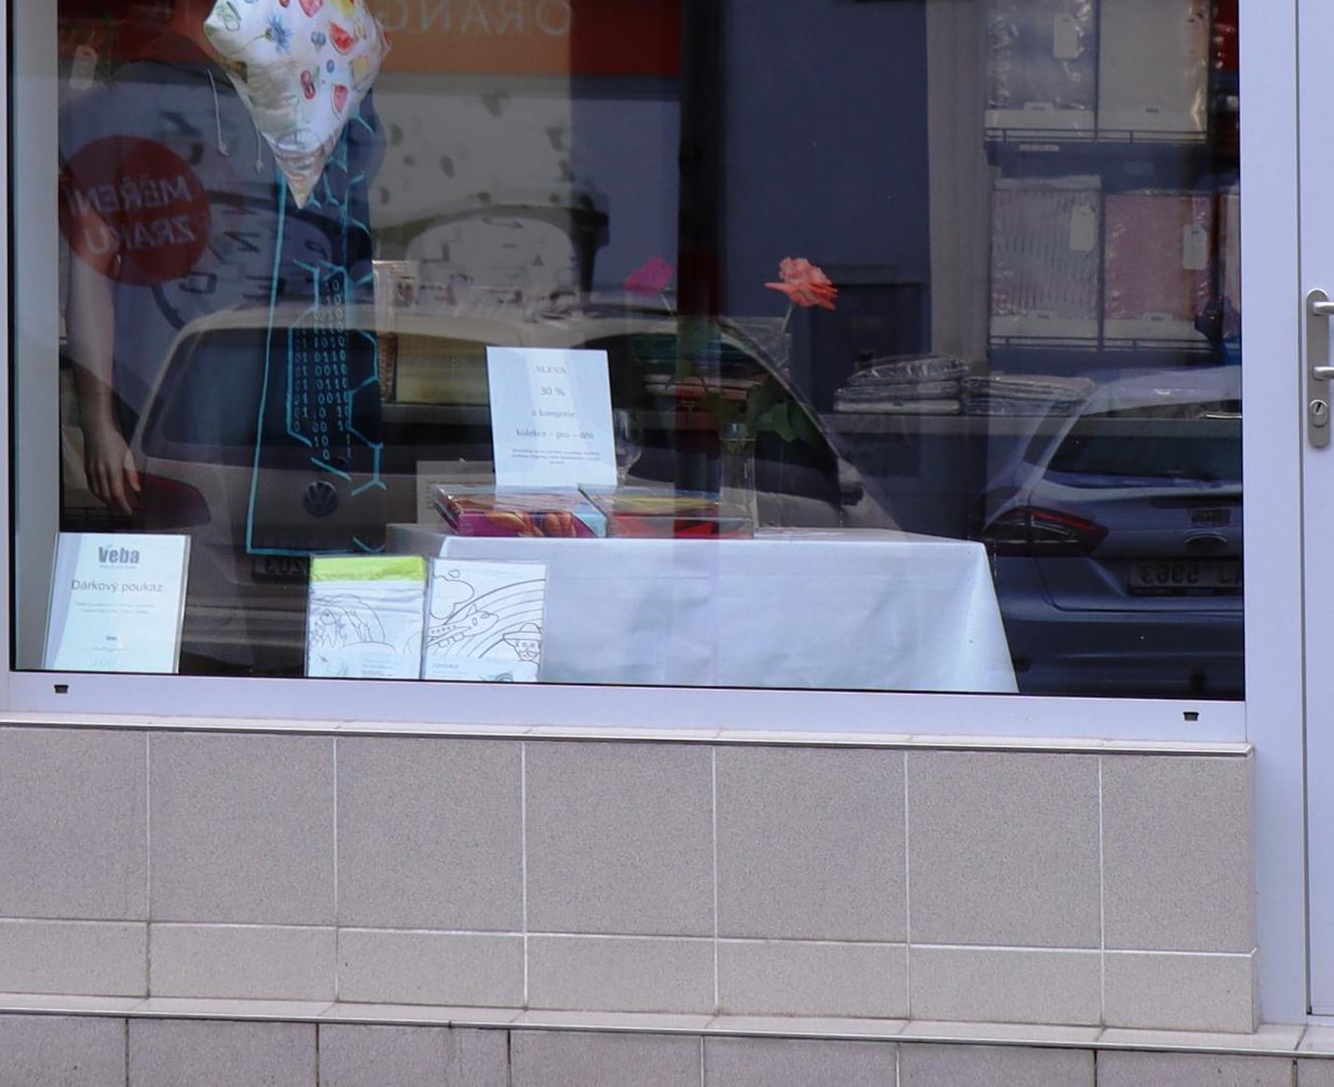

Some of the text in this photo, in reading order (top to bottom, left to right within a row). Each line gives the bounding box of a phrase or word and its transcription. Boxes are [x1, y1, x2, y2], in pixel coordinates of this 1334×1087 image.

[98, 544, 140, 564] Veba
[71, 580, 163, 594] Dárkový poukaz
